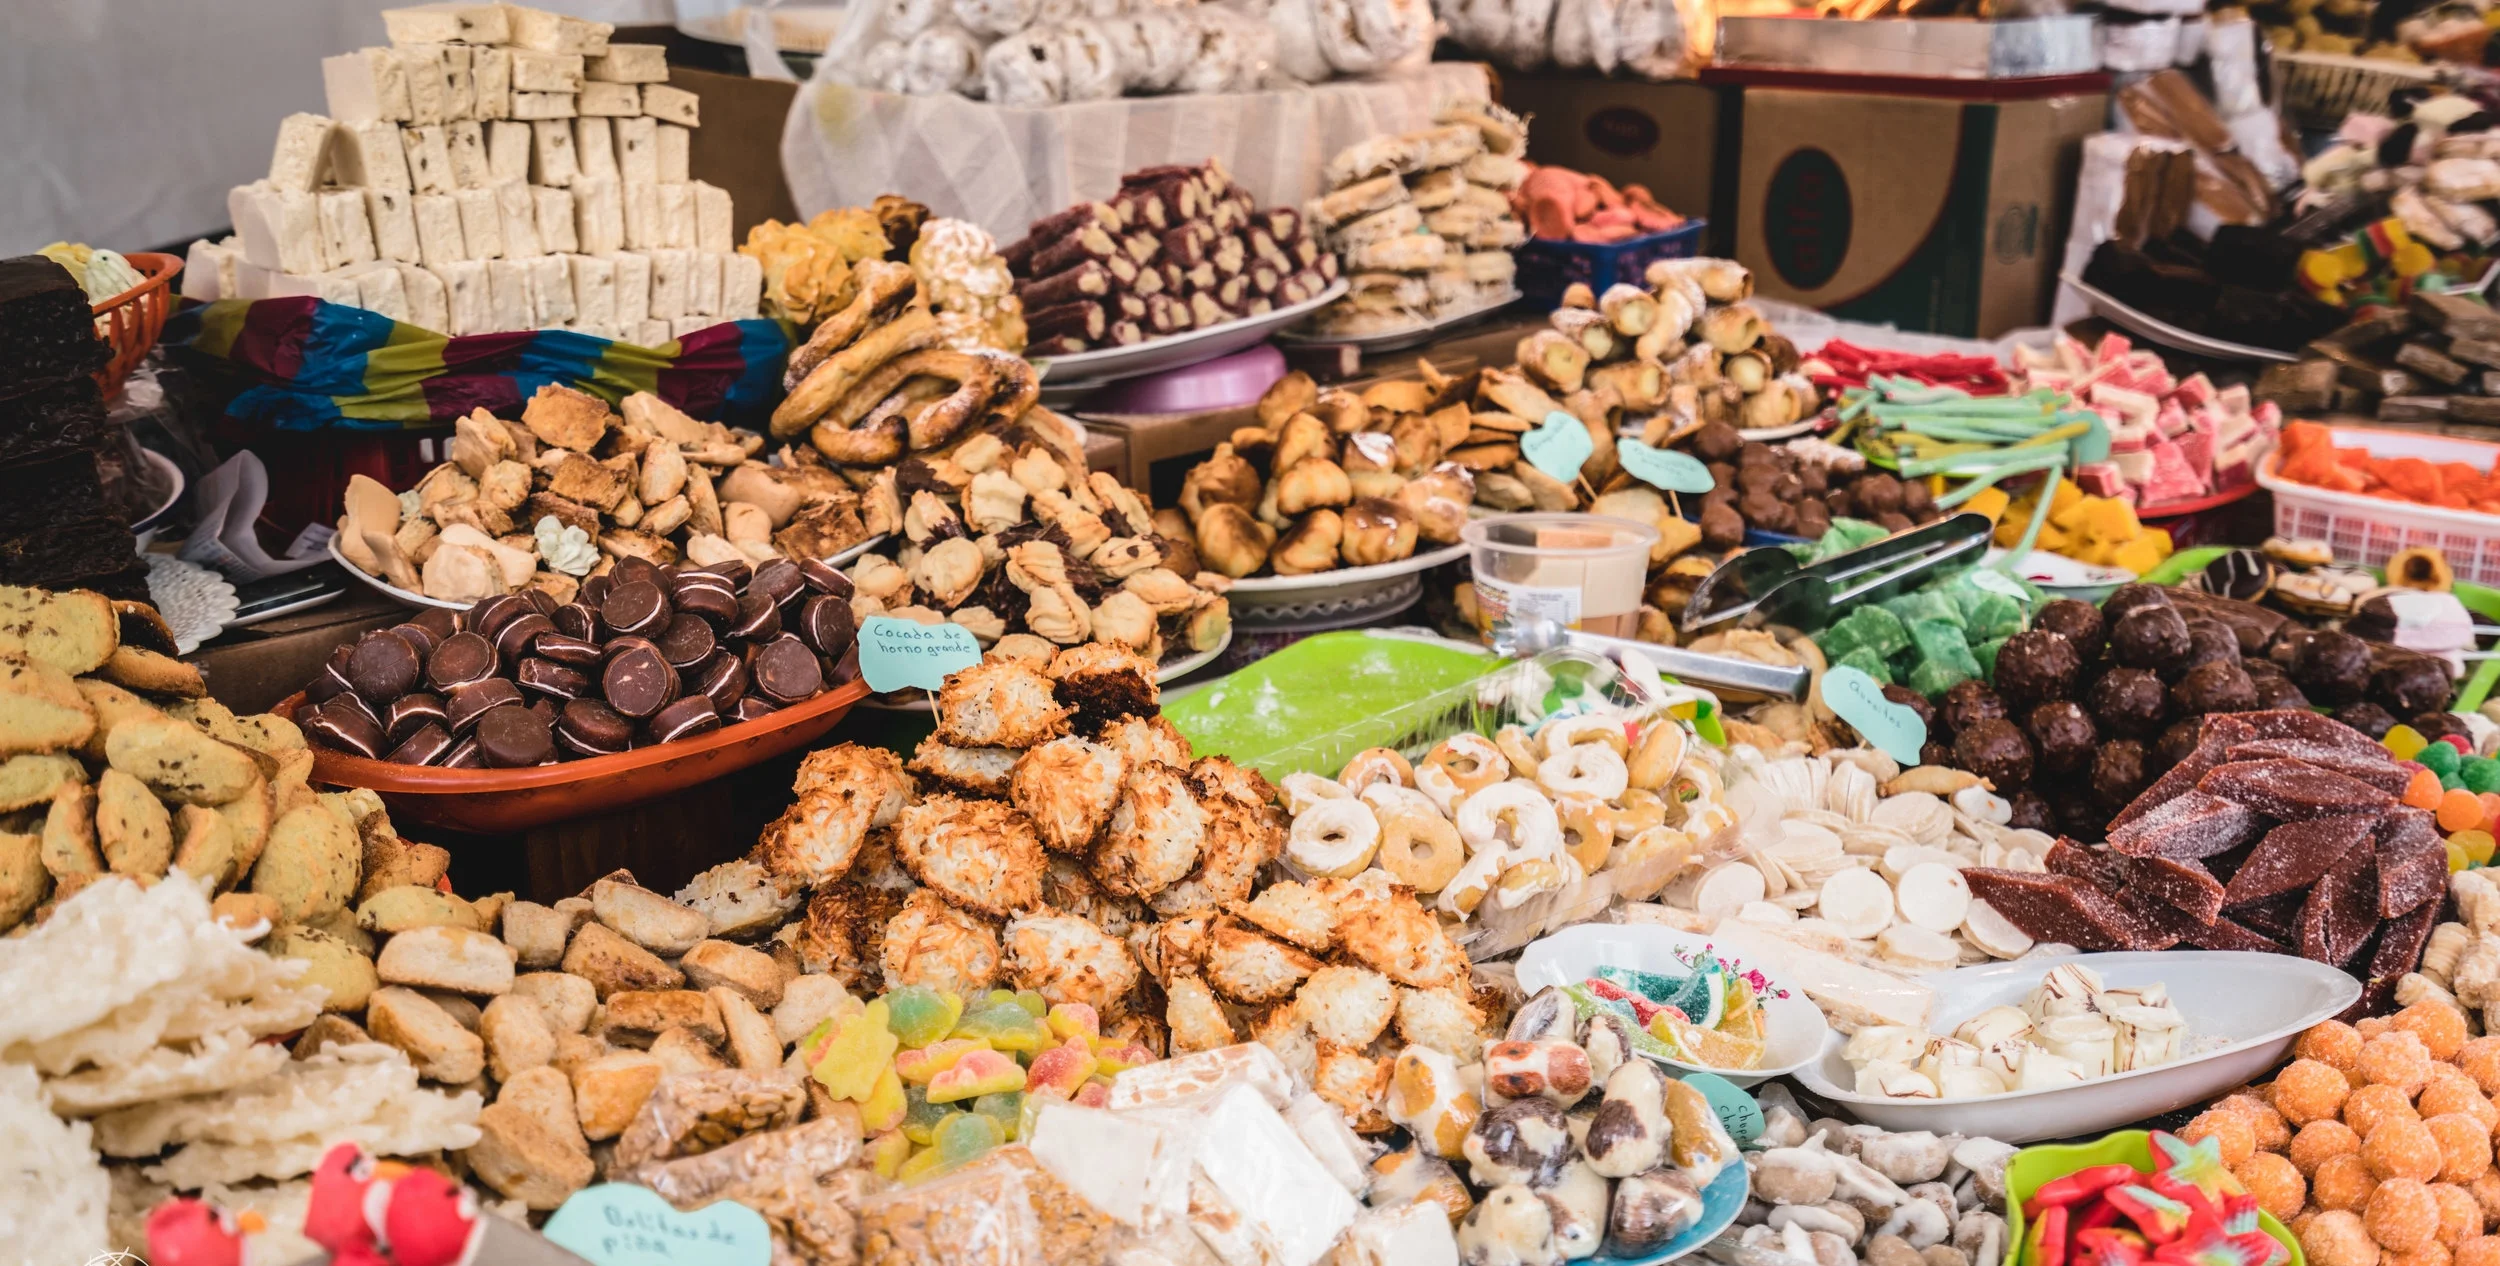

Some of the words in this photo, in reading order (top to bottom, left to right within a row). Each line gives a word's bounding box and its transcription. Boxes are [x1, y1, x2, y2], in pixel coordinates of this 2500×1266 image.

[873, 624, 934, 639] Cocada
[943, 628, 961, 640] de
[877, 639, 922, 654] horno
[927, 642, 971, 657] grande
